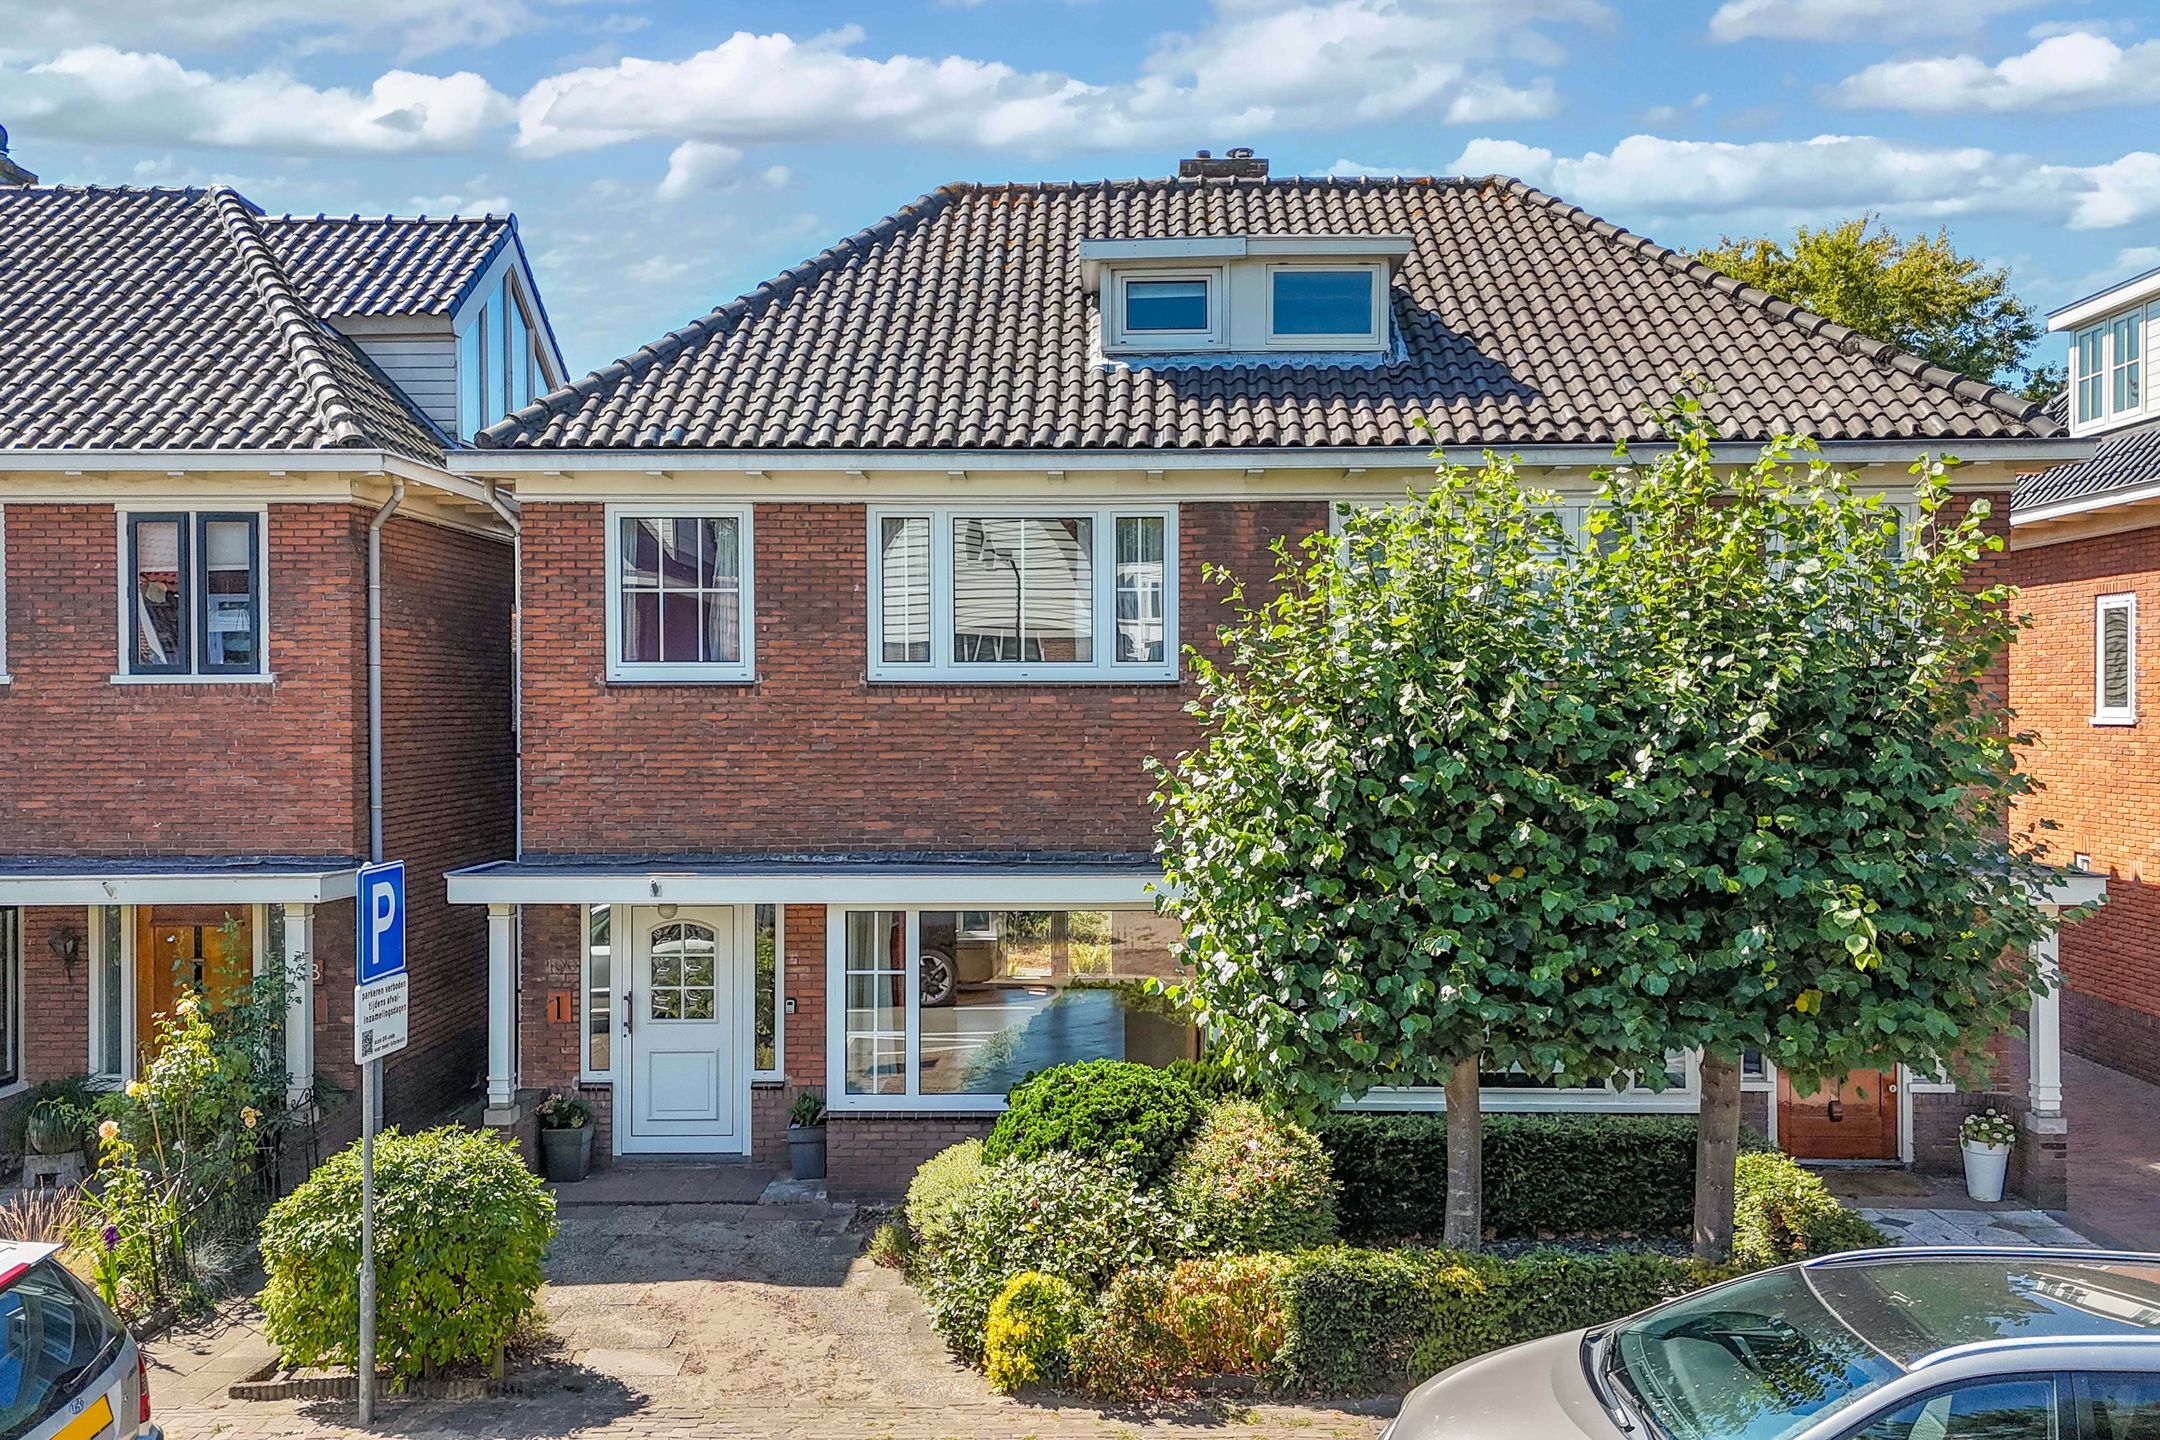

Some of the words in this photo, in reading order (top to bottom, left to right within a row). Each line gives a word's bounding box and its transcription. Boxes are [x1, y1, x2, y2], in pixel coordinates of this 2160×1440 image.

[372, 881, 396, 965] P
[362, 987, 384, 1002] parkeren
[385, 980, 406, 993] verboden
[363, 1003, 407, 1025] inzamelingsdagen
[368, 999, 386, 1012] tijdens
